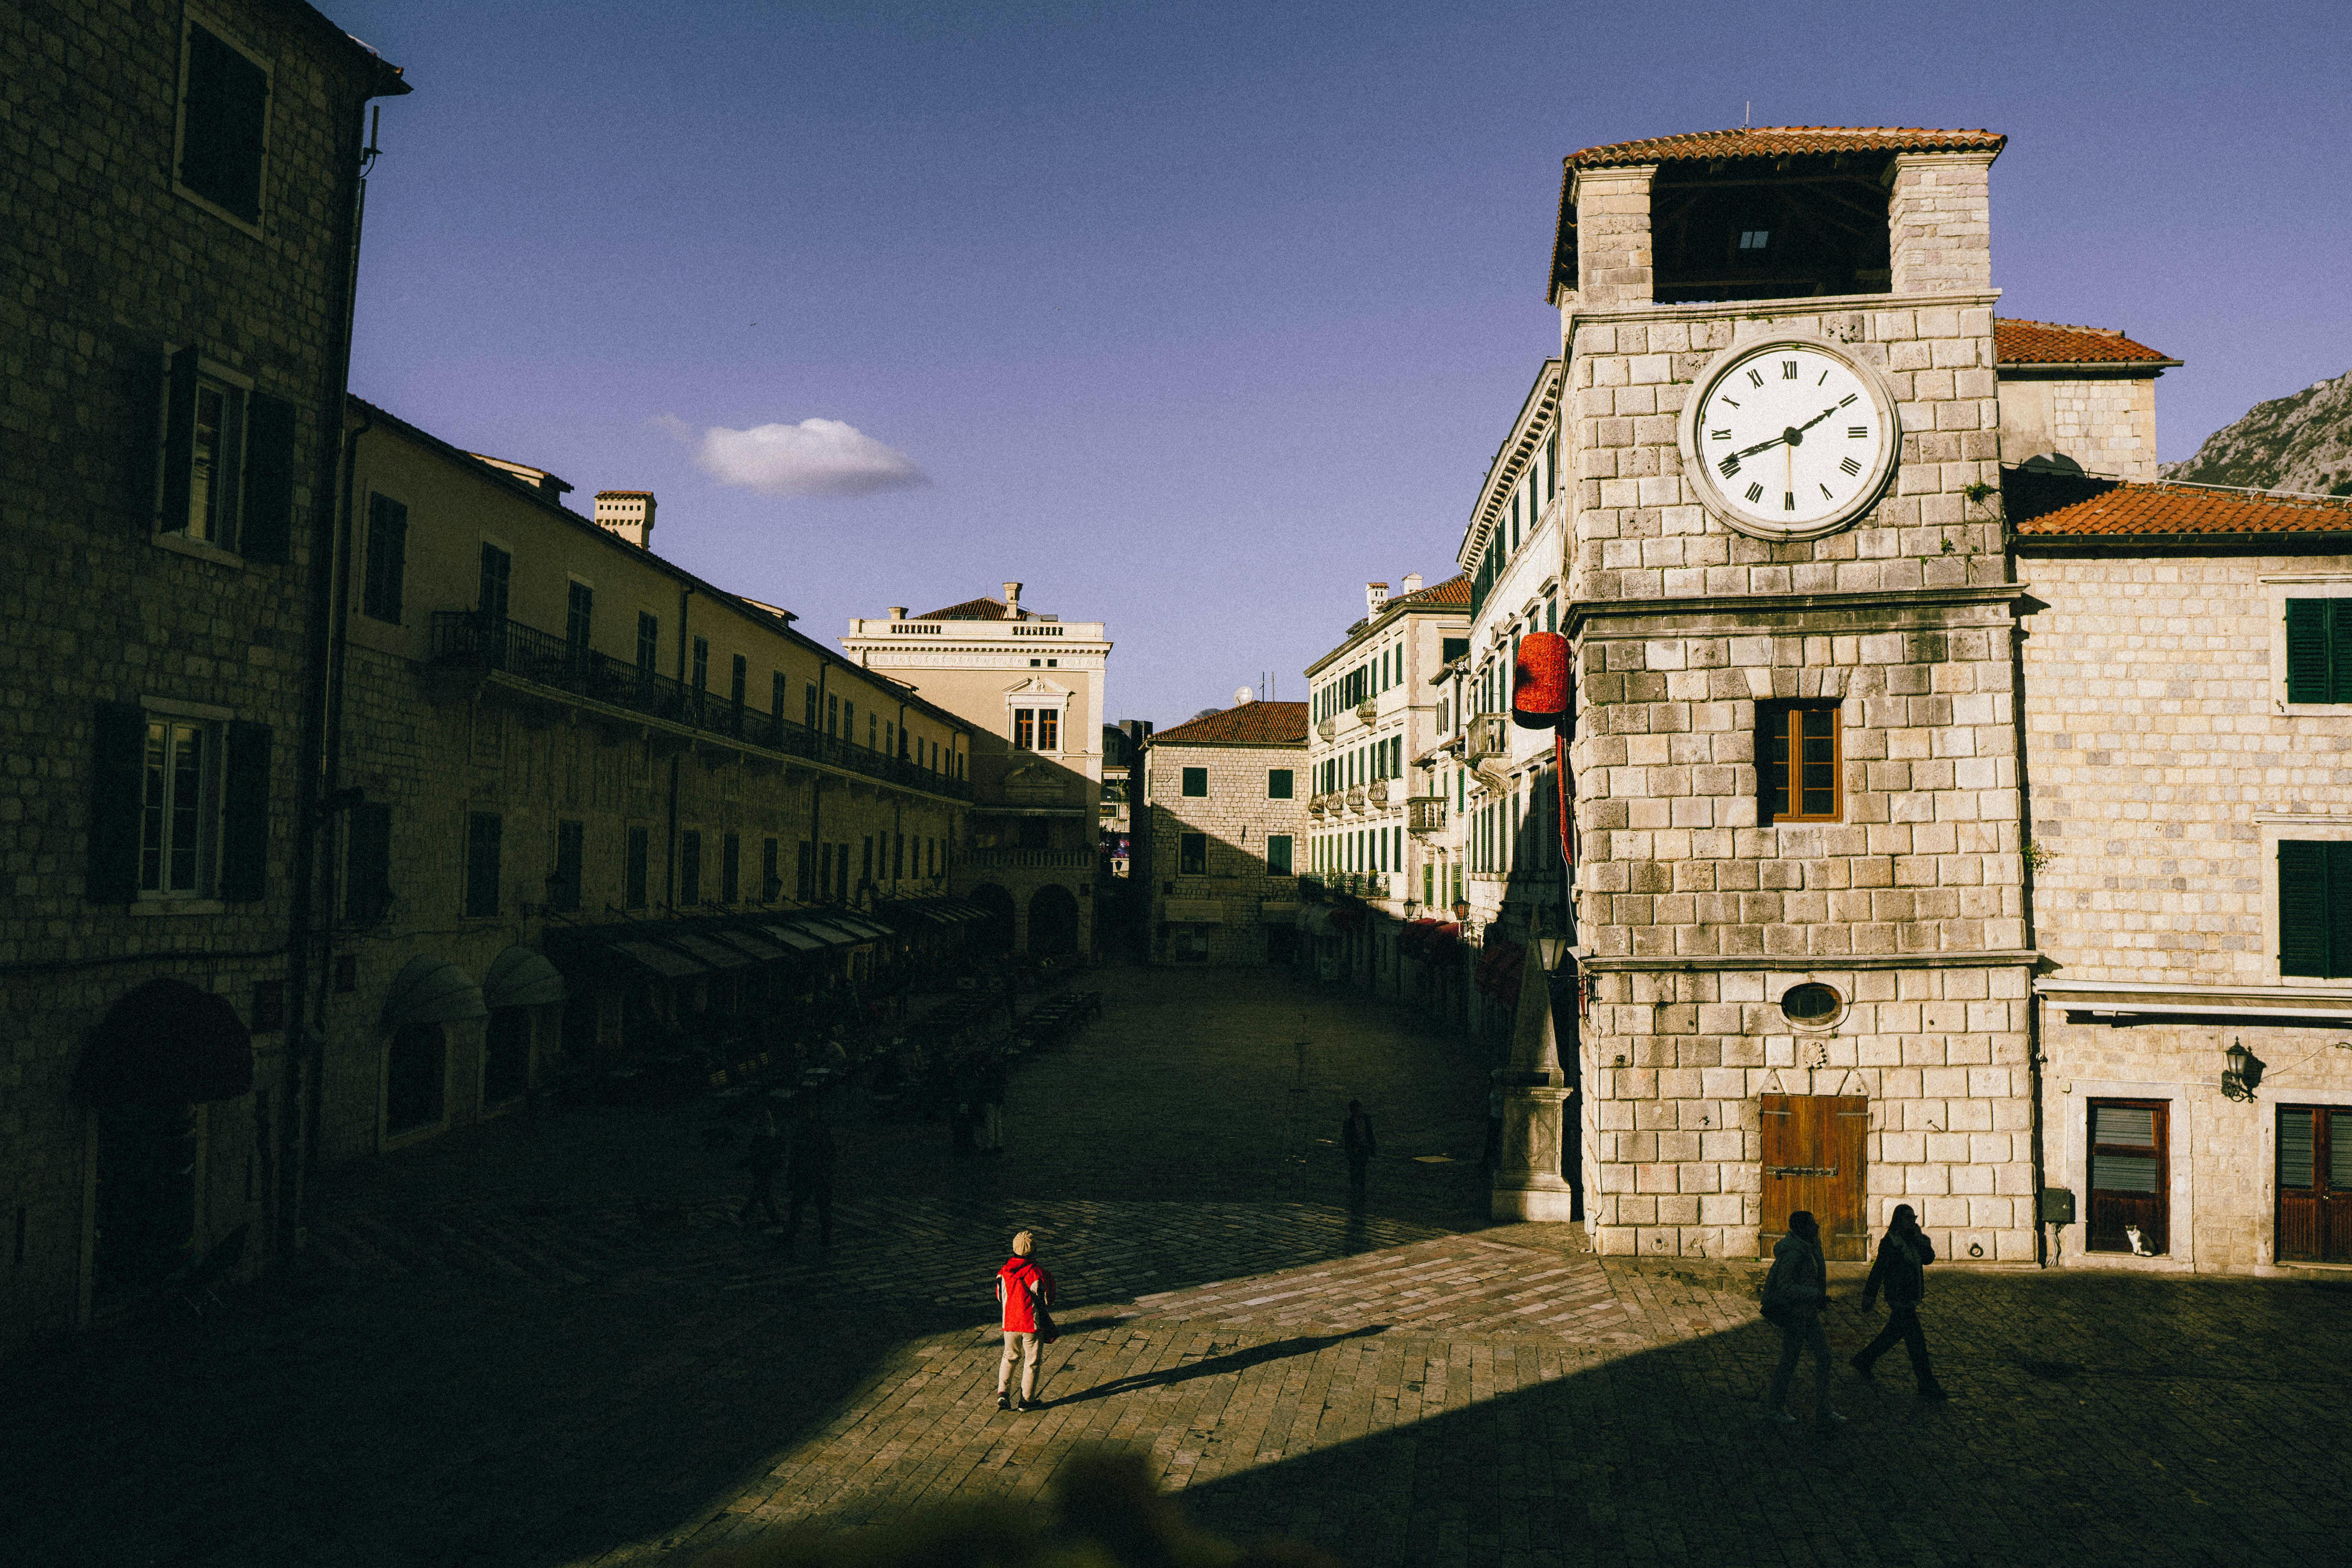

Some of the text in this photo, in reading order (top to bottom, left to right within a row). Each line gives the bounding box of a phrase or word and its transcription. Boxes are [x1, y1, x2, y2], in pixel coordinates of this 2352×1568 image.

[1782, 361, 1797, 379] XII
[1818, 370, 1828, 386] I
[1747, 369, 1764, 389] XI
[1722, 395, 1740, 409] X
[1839, 393, 1858, 408] II
[1711, 429, 1731, 440] IX
[1848, 427, 1867, 438] III
[1840, 457, 1861, 477] IIII
[1745, 482, 1763, 503] VII
[1820, 483, 1833, 500] V
[1785, 492, 1795, 510] VI
